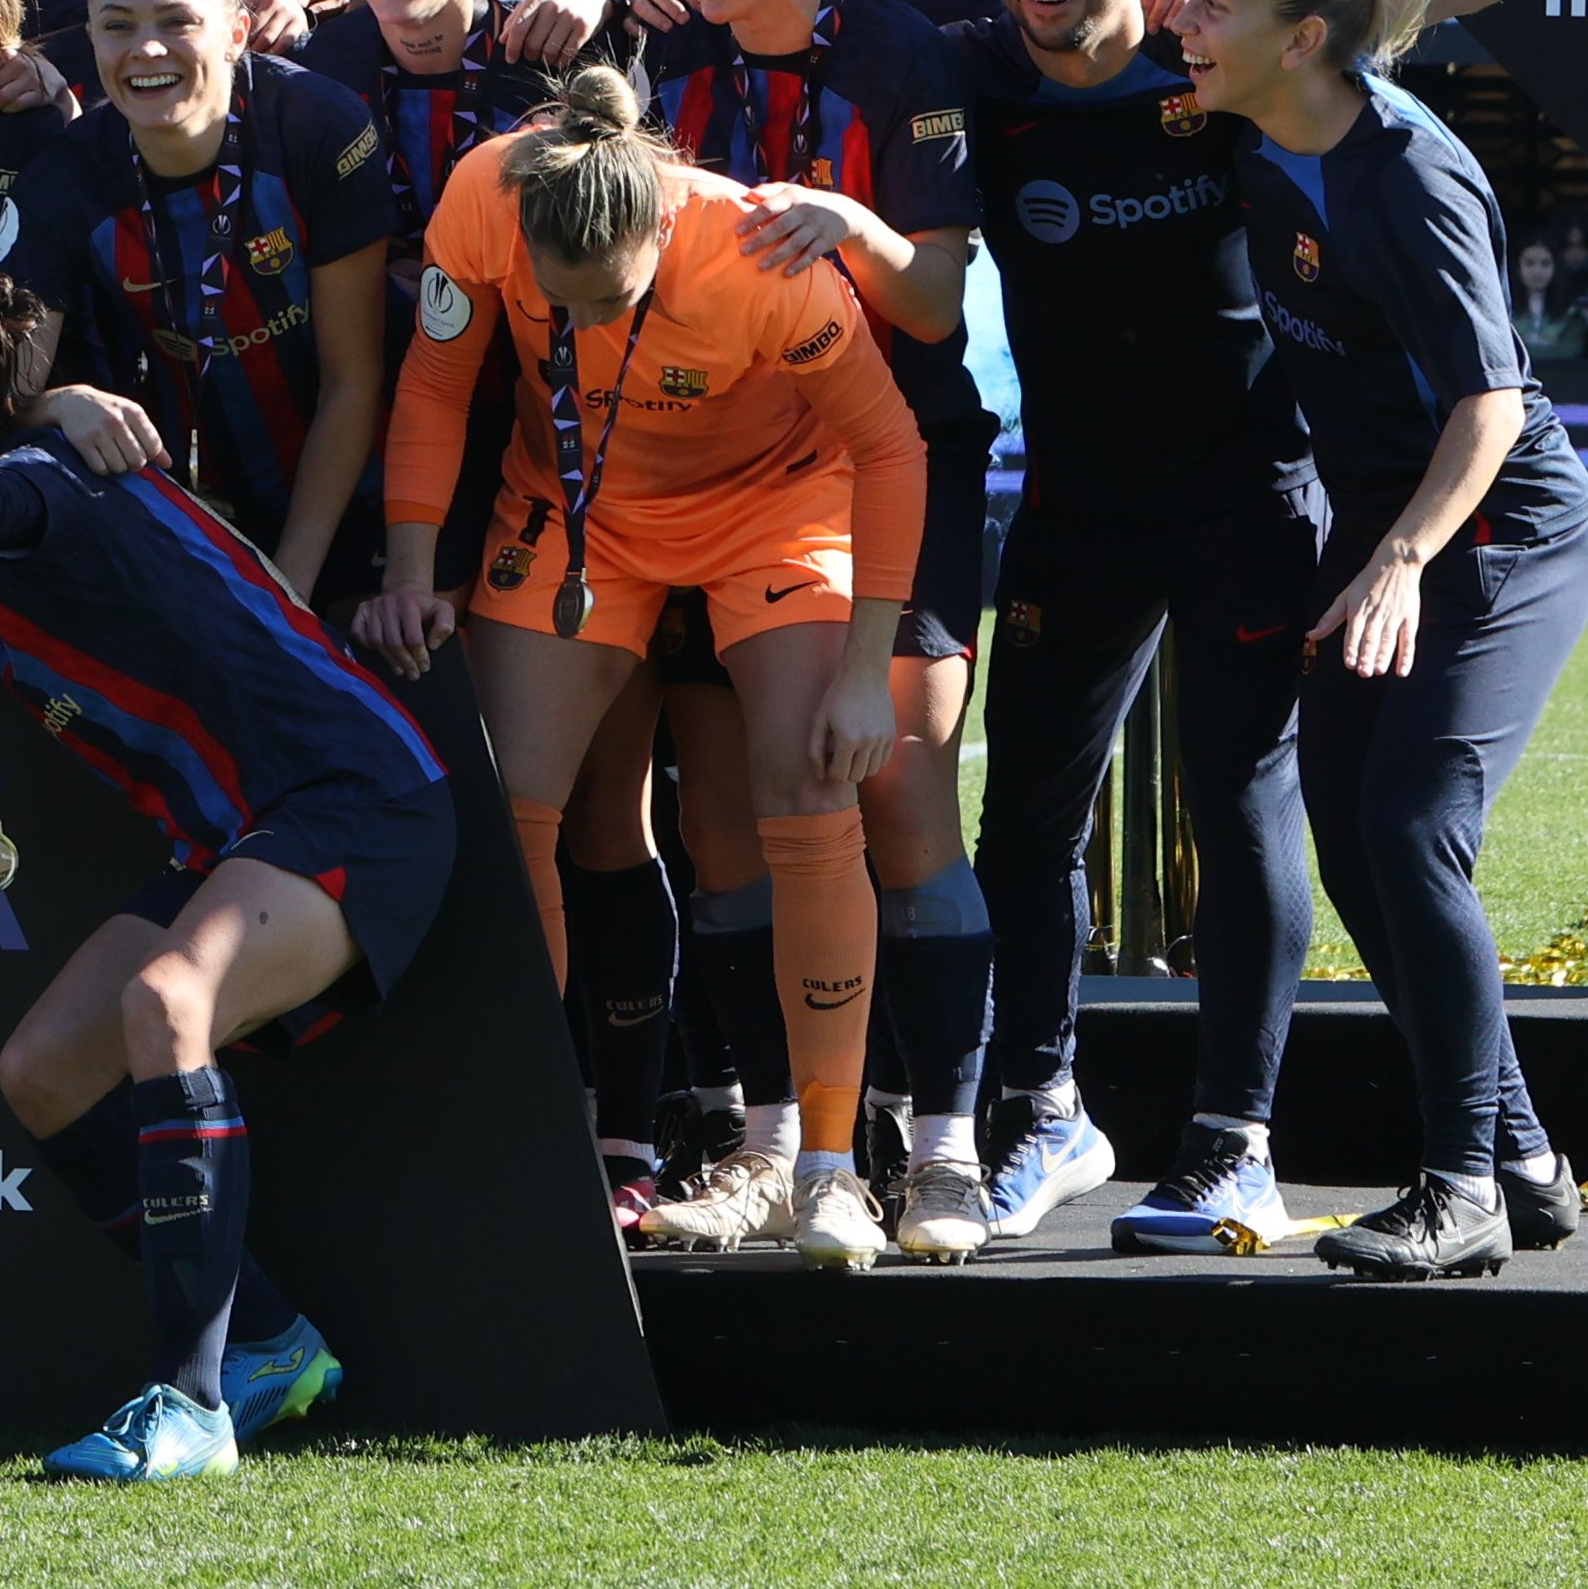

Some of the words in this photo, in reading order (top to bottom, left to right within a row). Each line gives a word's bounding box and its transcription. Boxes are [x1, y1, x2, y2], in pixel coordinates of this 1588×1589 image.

[336, 124, 378, 175] BIMBO
[1090, 173, 1226, 229] Spotify
[212, 299, 311, 357] Spotify
[783, 320, 841, 363] BIMBO
[585, 387, 693, 414] Spotify
[802, 975, 863, 994] CULERS
